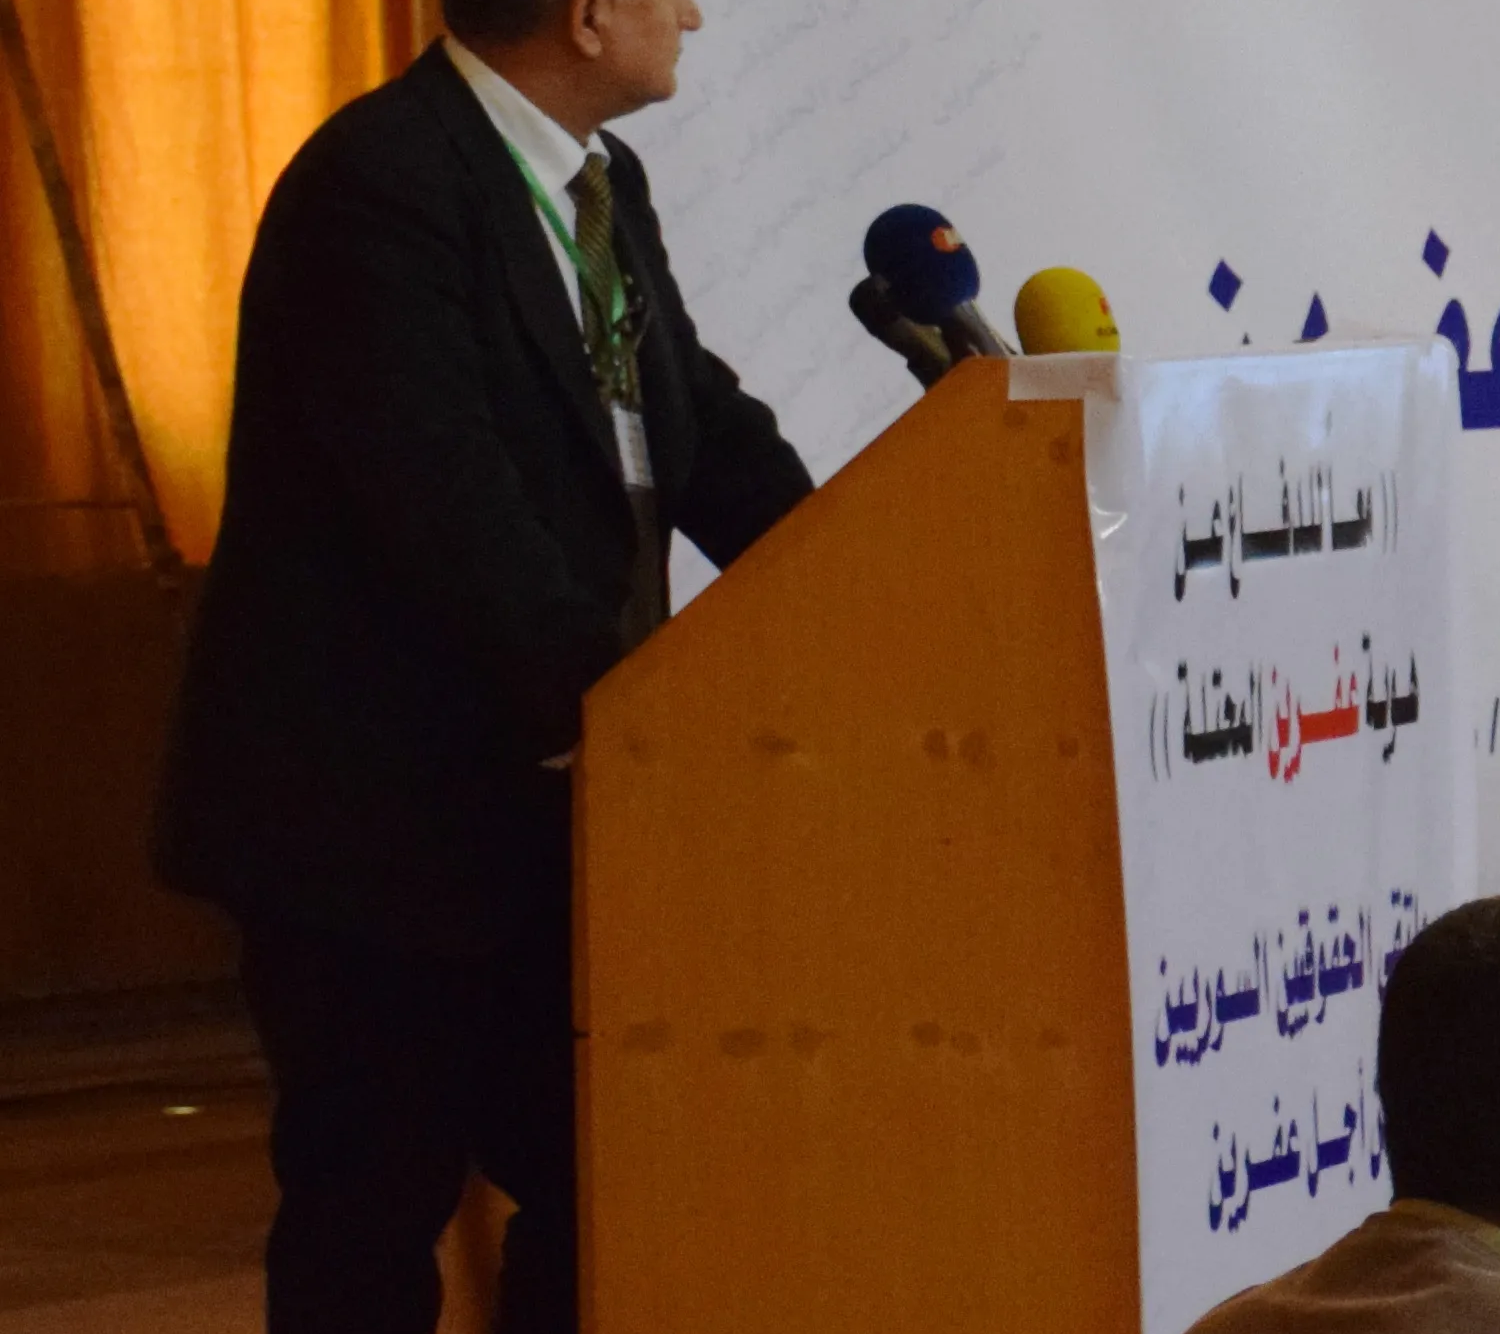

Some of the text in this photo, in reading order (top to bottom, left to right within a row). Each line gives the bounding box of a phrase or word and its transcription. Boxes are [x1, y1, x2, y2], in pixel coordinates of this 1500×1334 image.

[1174, 482, 1224, 603] عن
[1228, 456, 1323, 600] للدفاع
[1177, 658, 1264, 765] المحتلة
[1268, 642, 1360, 784] عفرين
[1361, 629, 1419, 766] هوية
[1155, 932, 1270, 1068] السوريين
[1276, 904, 1373, 1041] الحقوقيين
[1209, 1093, 1301, 1233] عفرين
[1307, 1055, 1366, 1199] أجل
